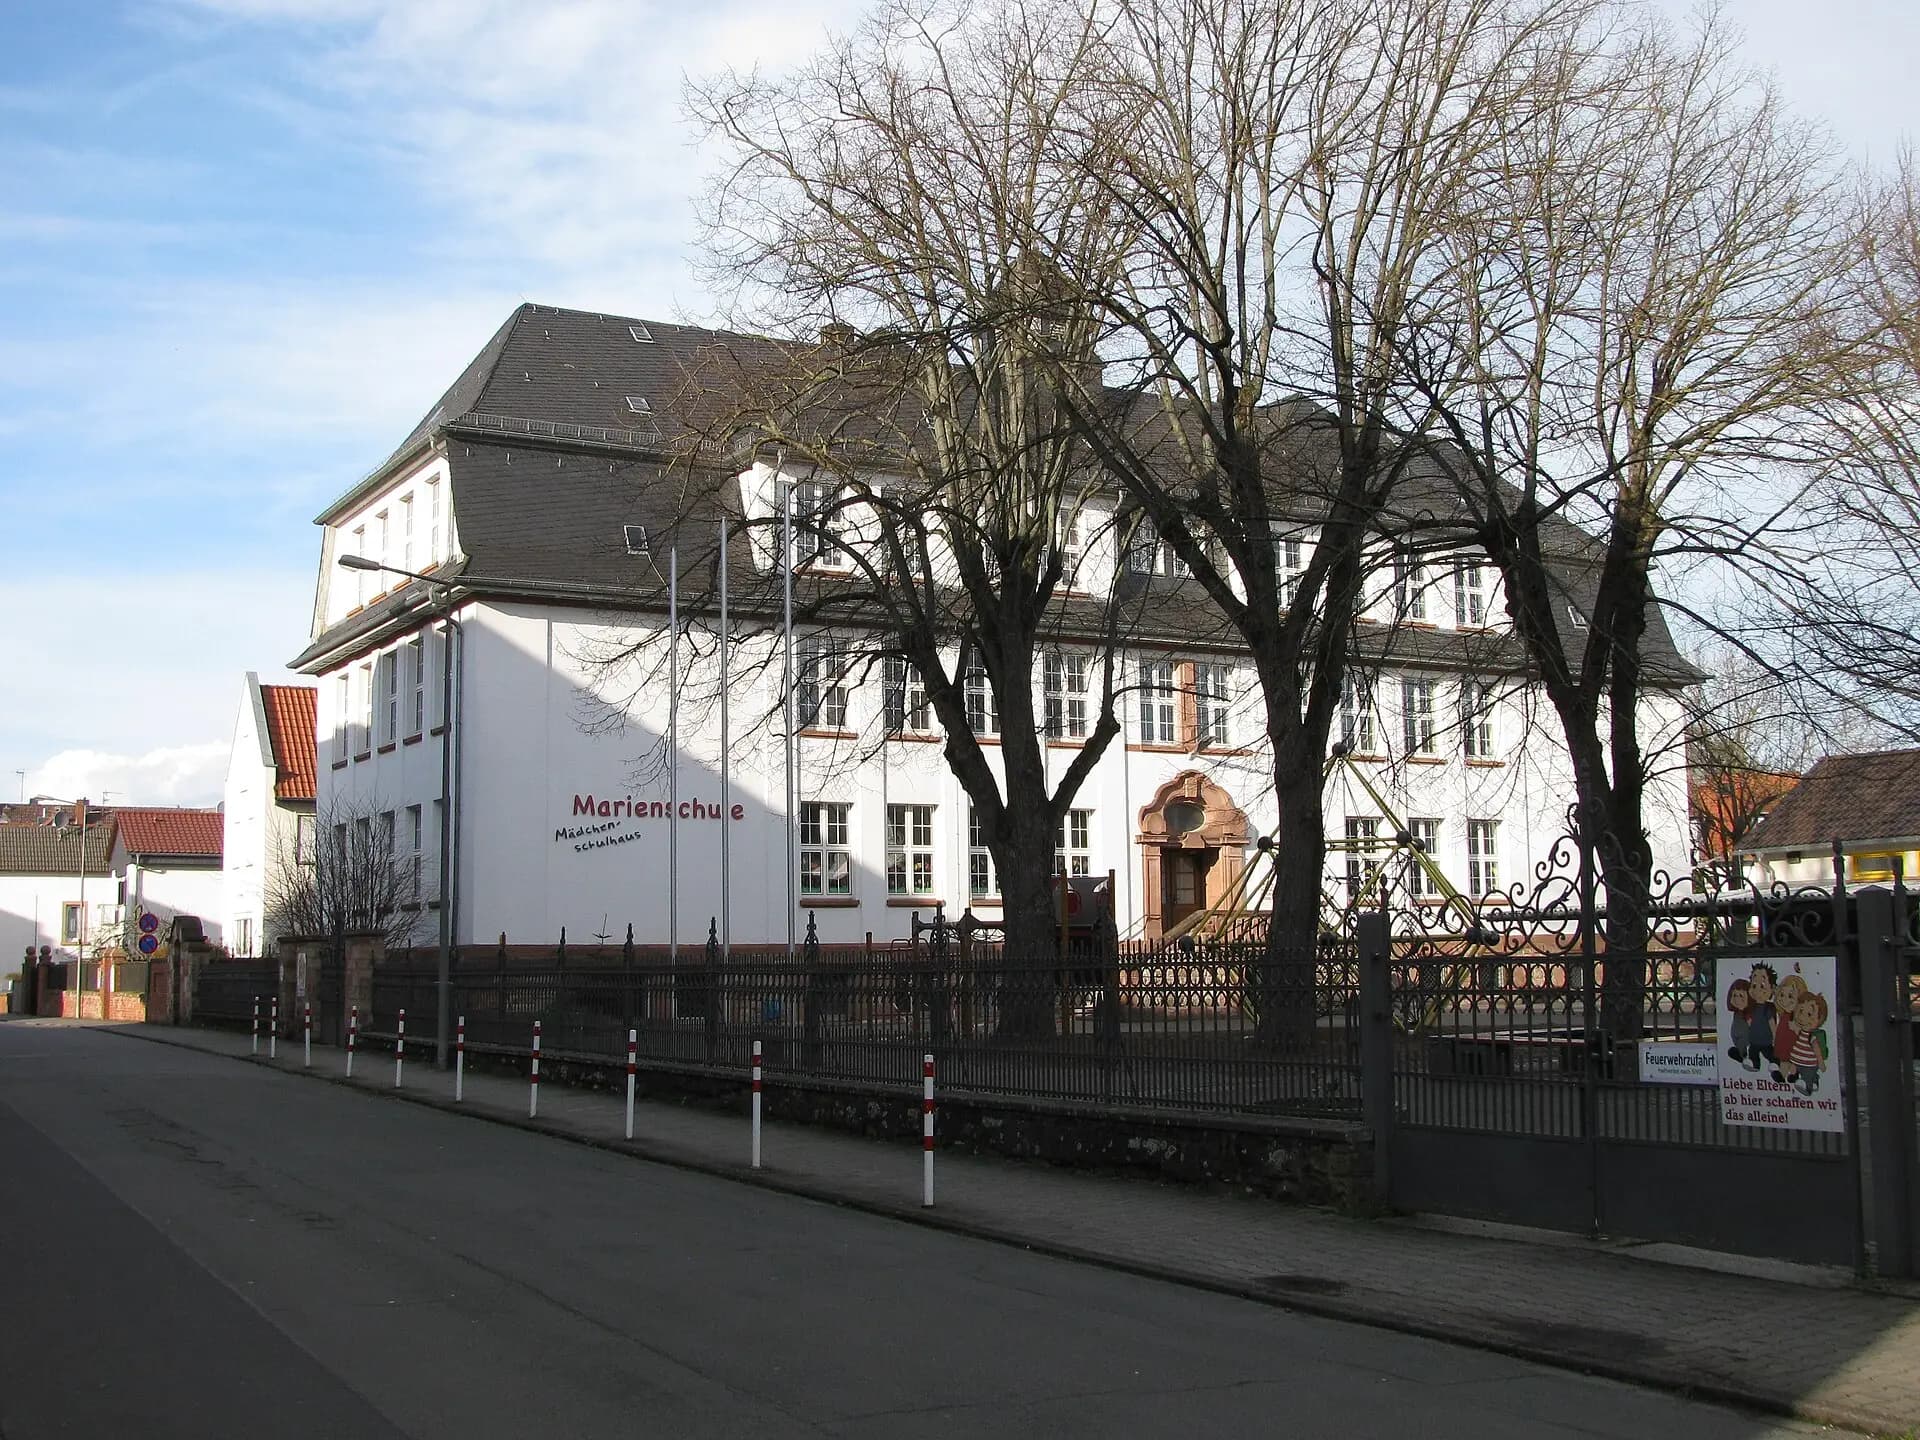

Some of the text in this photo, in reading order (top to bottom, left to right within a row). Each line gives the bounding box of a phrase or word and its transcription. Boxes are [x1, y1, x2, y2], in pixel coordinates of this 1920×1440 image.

[572, 794, 745, 820] Marienschue
[555, 820, 621, 842] Mädchen-
[1645, 1051, 1715, 1067] Feuerwehrzufahrt
[1723, 1078, 1796, 1094] Liebe Eltern,
[1724, 1094, 1837, 1111] ab hier schaffen wir
[1725, 1108, 1789, 1124] das alleine!
